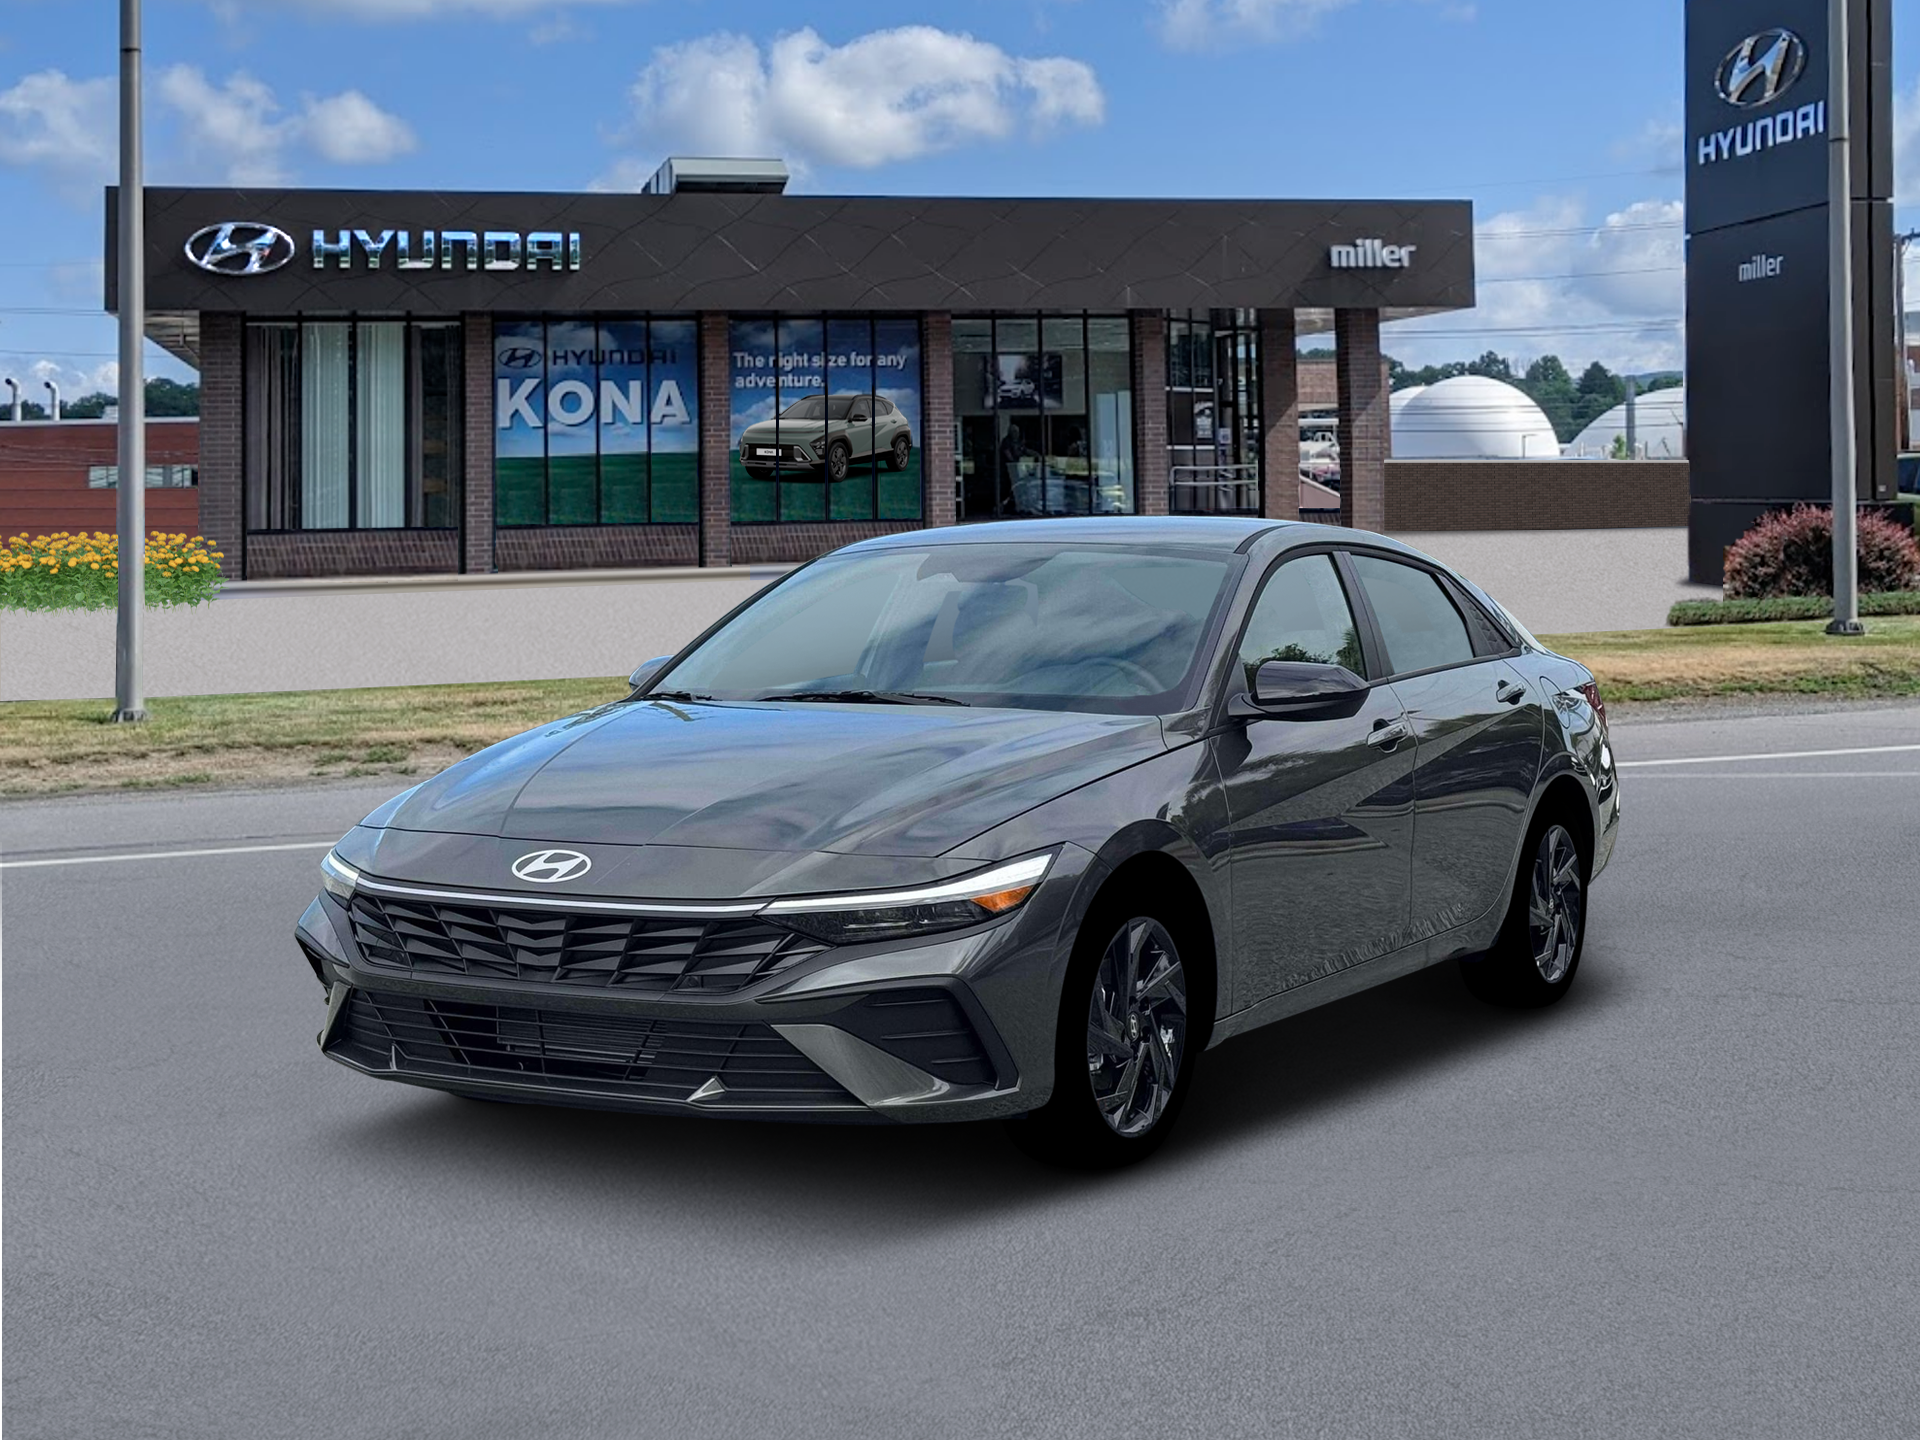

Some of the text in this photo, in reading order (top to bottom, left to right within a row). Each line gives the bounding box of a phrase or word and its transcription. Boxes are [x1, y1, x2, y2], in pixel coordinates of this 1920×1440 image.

[1698, 100, 1825, 166] HYUNDAI
[311, 229, 581, 271] HYUNDAI
[1330, 238, 1417, 268] miller
[1738, 254, 1784, 282] miller
[552, 349, 677, 366] HYUNDAI
[734, 352, 907, 370] The right size for any
[735, 373, 826, 388] adventure.
[497, 377, 691, 429] KONA
